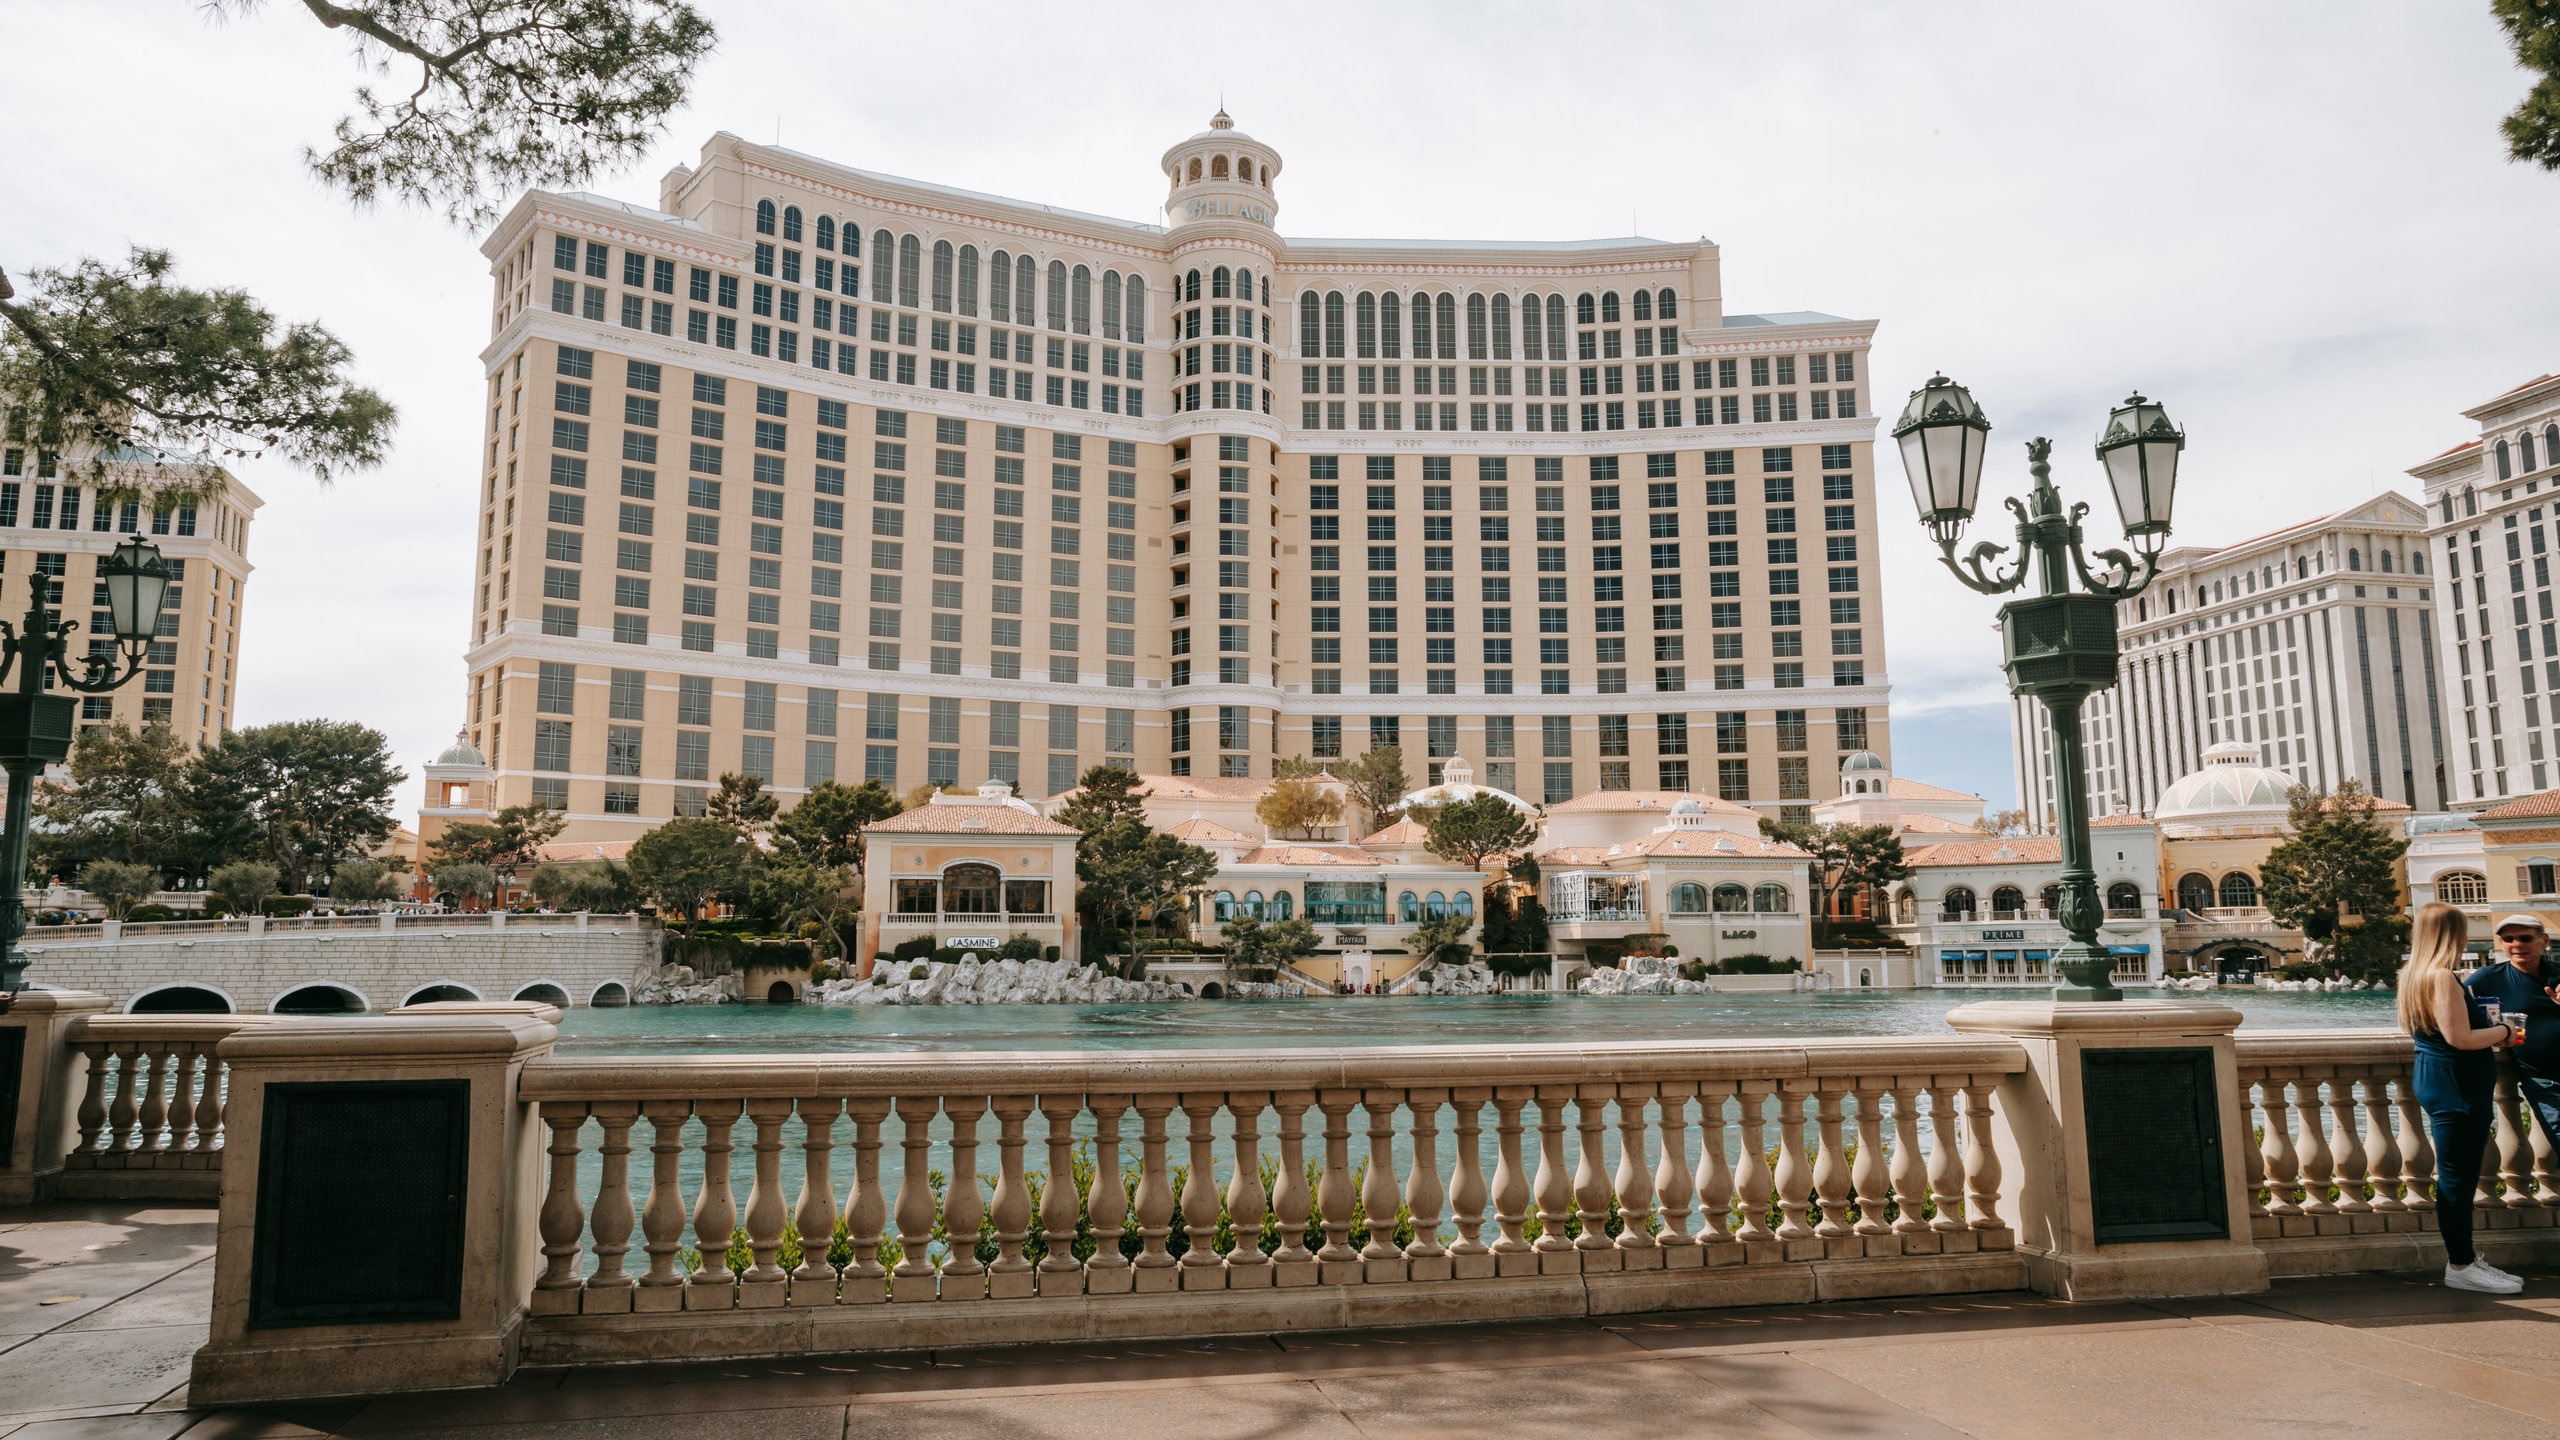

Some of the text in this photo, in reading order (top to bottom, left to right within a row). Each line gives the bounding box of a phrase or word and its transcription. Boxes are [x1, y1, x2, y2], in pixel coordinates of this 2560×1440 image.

[1183, 199, 1275, 228] BELLAGIO
[1721, 930, 1757, 939] LAGO
[1985, 930, 2021, 940] PRIME
[950, 938, 996, 948] JASMINE
[1338, 936, 1365, 944] MAYFAIR
